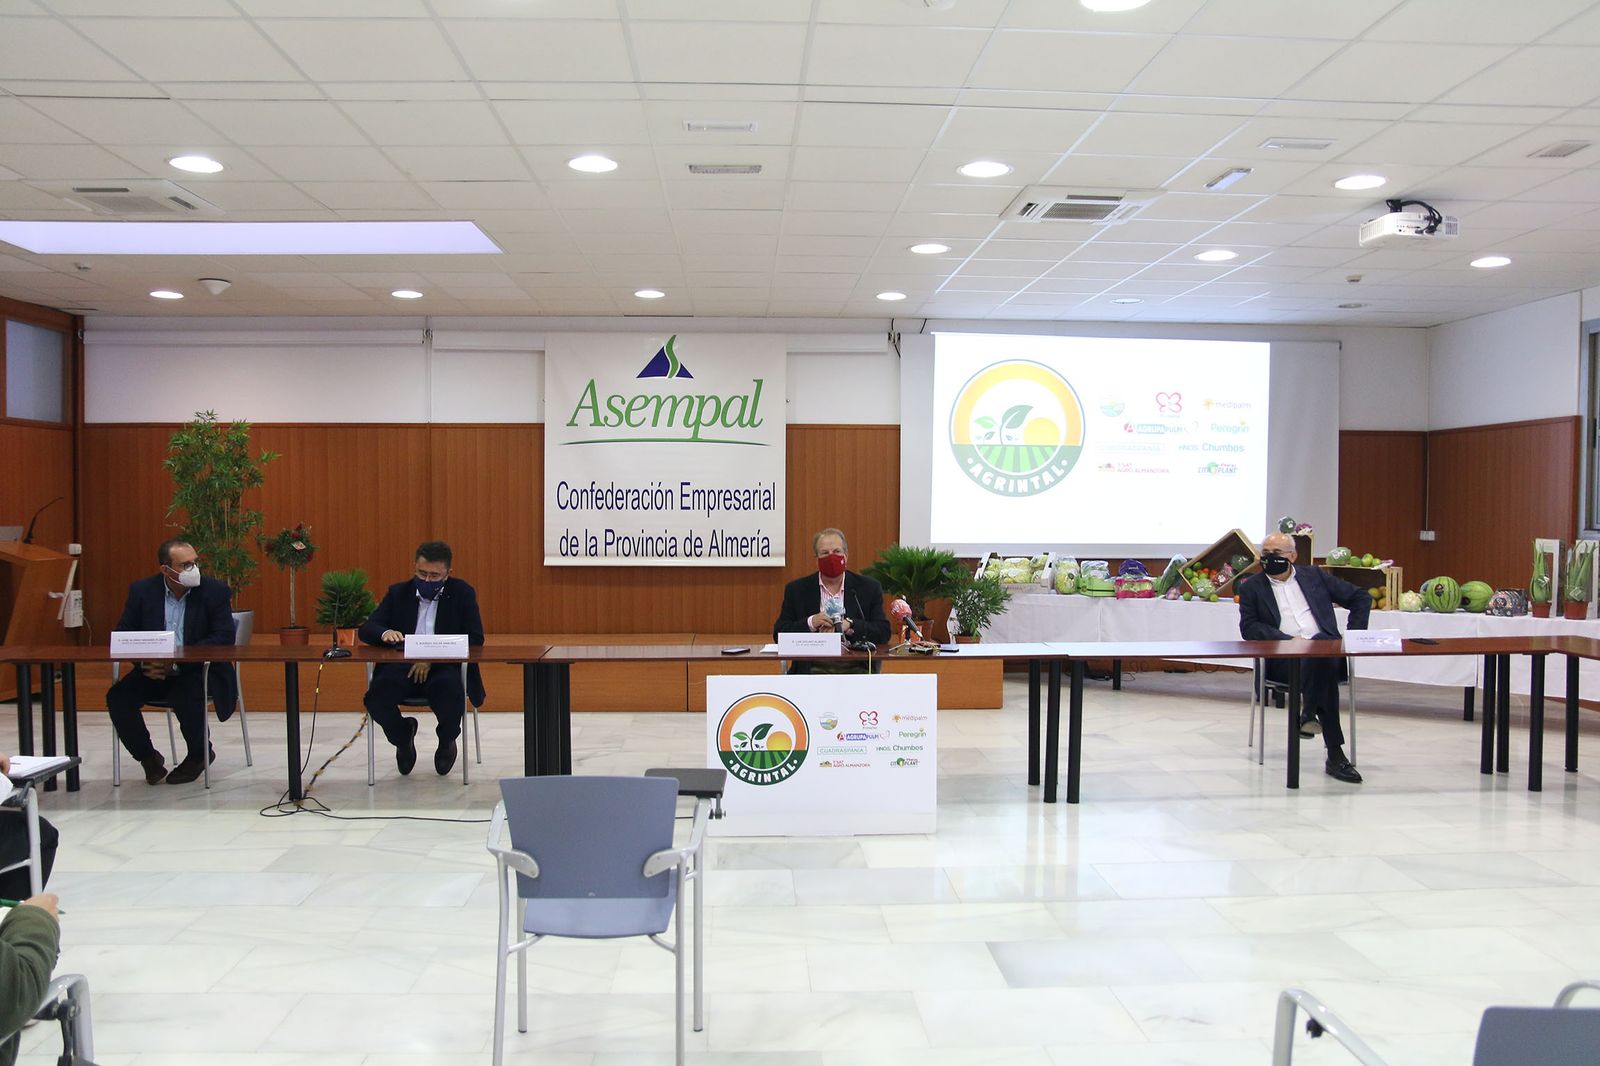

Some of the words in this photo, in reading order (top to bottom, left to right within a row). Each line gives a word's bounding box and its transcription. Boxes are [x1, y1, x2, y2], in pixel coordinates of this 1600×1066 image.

[566, 378, 763, 439] Asempal
[1201, 442, 1245, 452] Chumbos
[969, 464, 1065, 493] AGRINTAL
[556, 481, 674, 511] Confederación
[680, 482, 775, 518] Empresarial
[559, 529, 578, 557] de
[585, 529, 597, 557] la
[604, 529, 677, 557] Provincia
[683, 529, 702, 557] de
[708, 529, 770, 557] Almería
[731, 762, 796, 783] AGRINTAL
